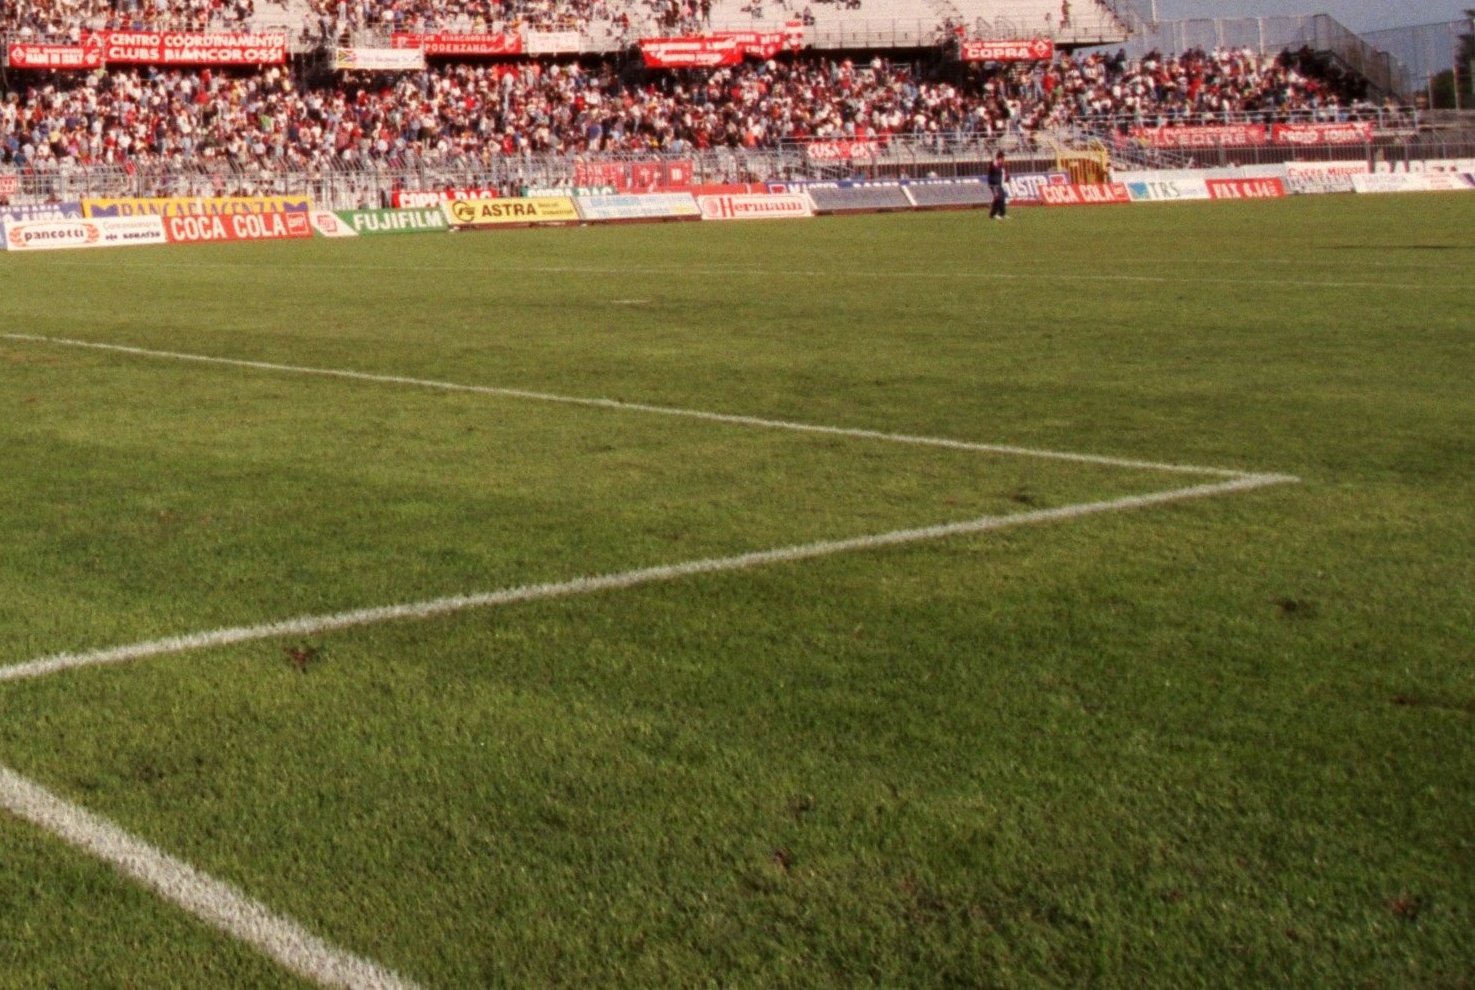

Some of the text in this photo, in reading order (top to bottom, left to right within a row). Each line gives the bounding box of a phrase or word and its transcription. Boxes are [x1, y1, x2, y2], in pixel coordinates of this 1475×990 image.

[110, 32, 285, 48] CENTRO COORDINAMENTO
[109, 47, 283, 61] CLUBS BIANCOROSSI
[1042, 185, 1079, 204] COCA
[1079, 184, 1116, 202] COLA
[482, 202, 537, 218] ASTRA
[719, 197, 803, 218] Hermann
[170, 215, 227, 241] COCA
[232, 213, 288, 239] COLA
[353, 210, 443, 231] FUJIFILM
[24, 227, 85, 243] pancotti
